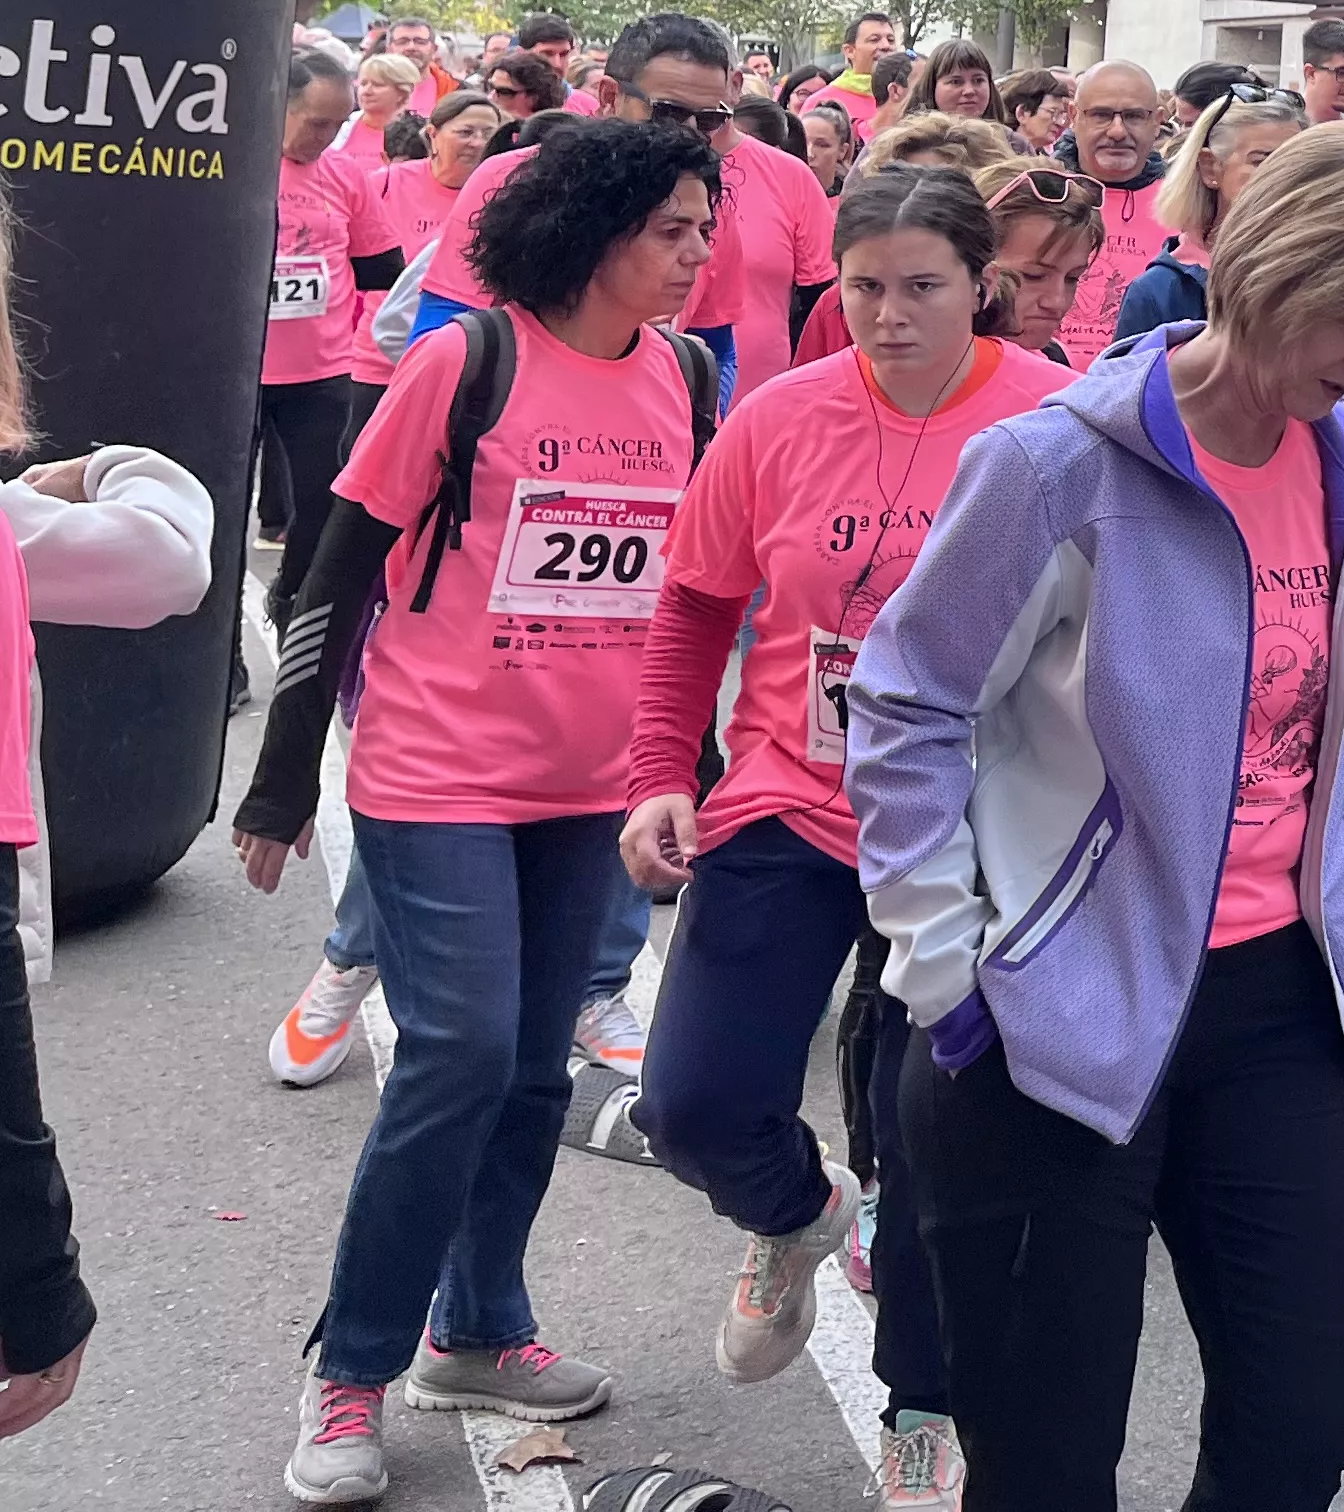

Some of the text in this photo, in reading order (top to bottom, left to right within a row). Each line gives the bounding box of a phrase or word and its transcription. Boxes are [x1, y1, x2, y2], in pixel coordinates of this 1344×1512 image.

[537, 437, 571, 473] 9ª
[576, 432, 663, 459] CÁNCER
[620, 456, 676, 475] HUESCA
[531, 507, 669, 529] CONTRA EL CÁNCER
[585, 499, 627, 512] HUESCA
[829, 513, 871, 553] 9ª
[533, 531, 649, 584] 290
